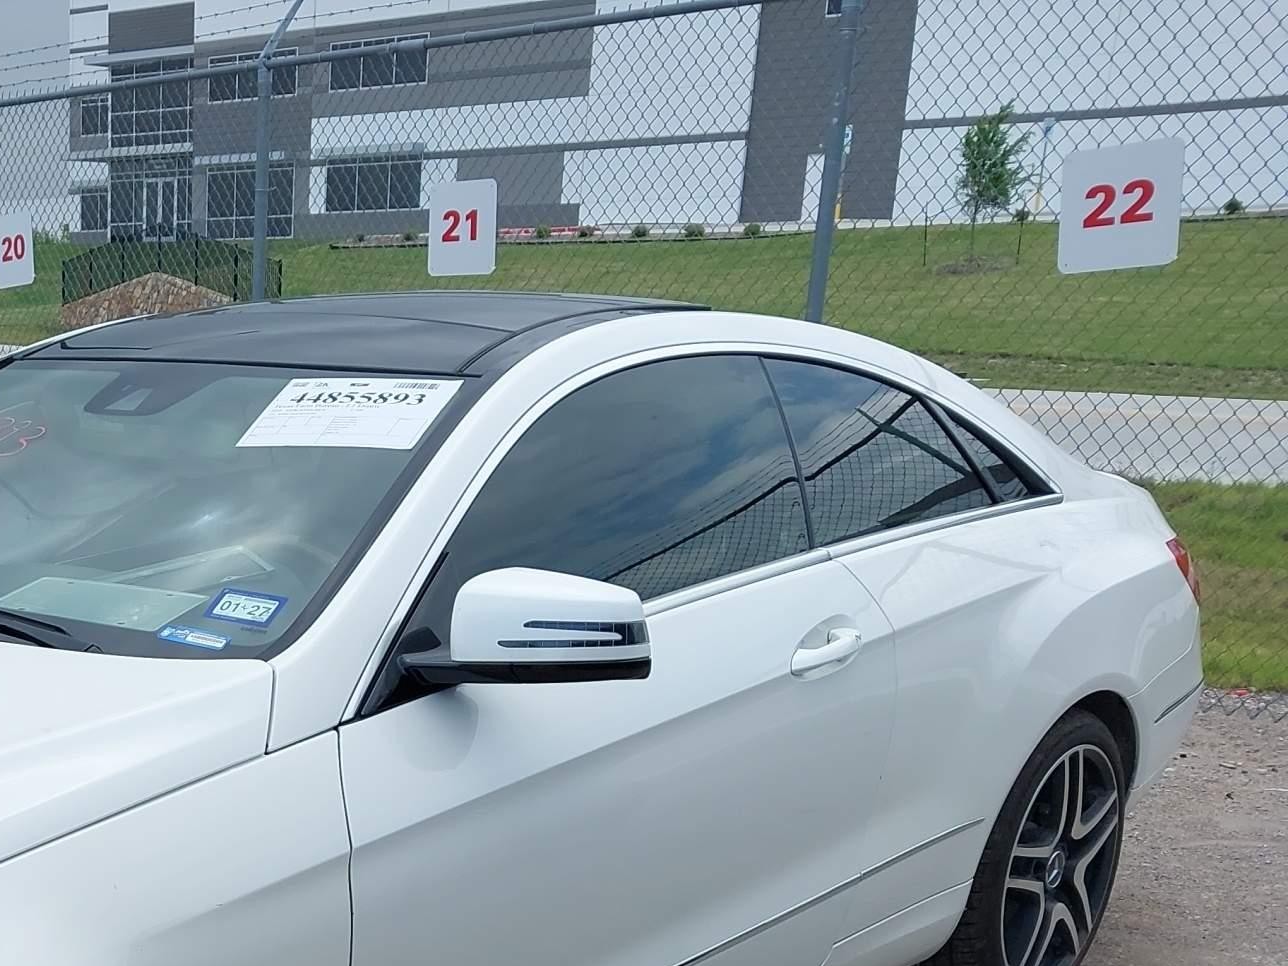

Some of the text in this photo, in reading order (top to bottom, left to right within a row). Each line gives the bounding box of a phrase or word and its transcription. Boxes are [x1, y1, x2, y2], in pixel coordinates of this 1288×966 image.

[1083, 180, 1154, 228] 22
[442, 209, 478, 242] 21
[1, 235, 25, 262] 20
[289, 390, 427, 406] 44855893
[220, 600, 272, 618] 01 27
